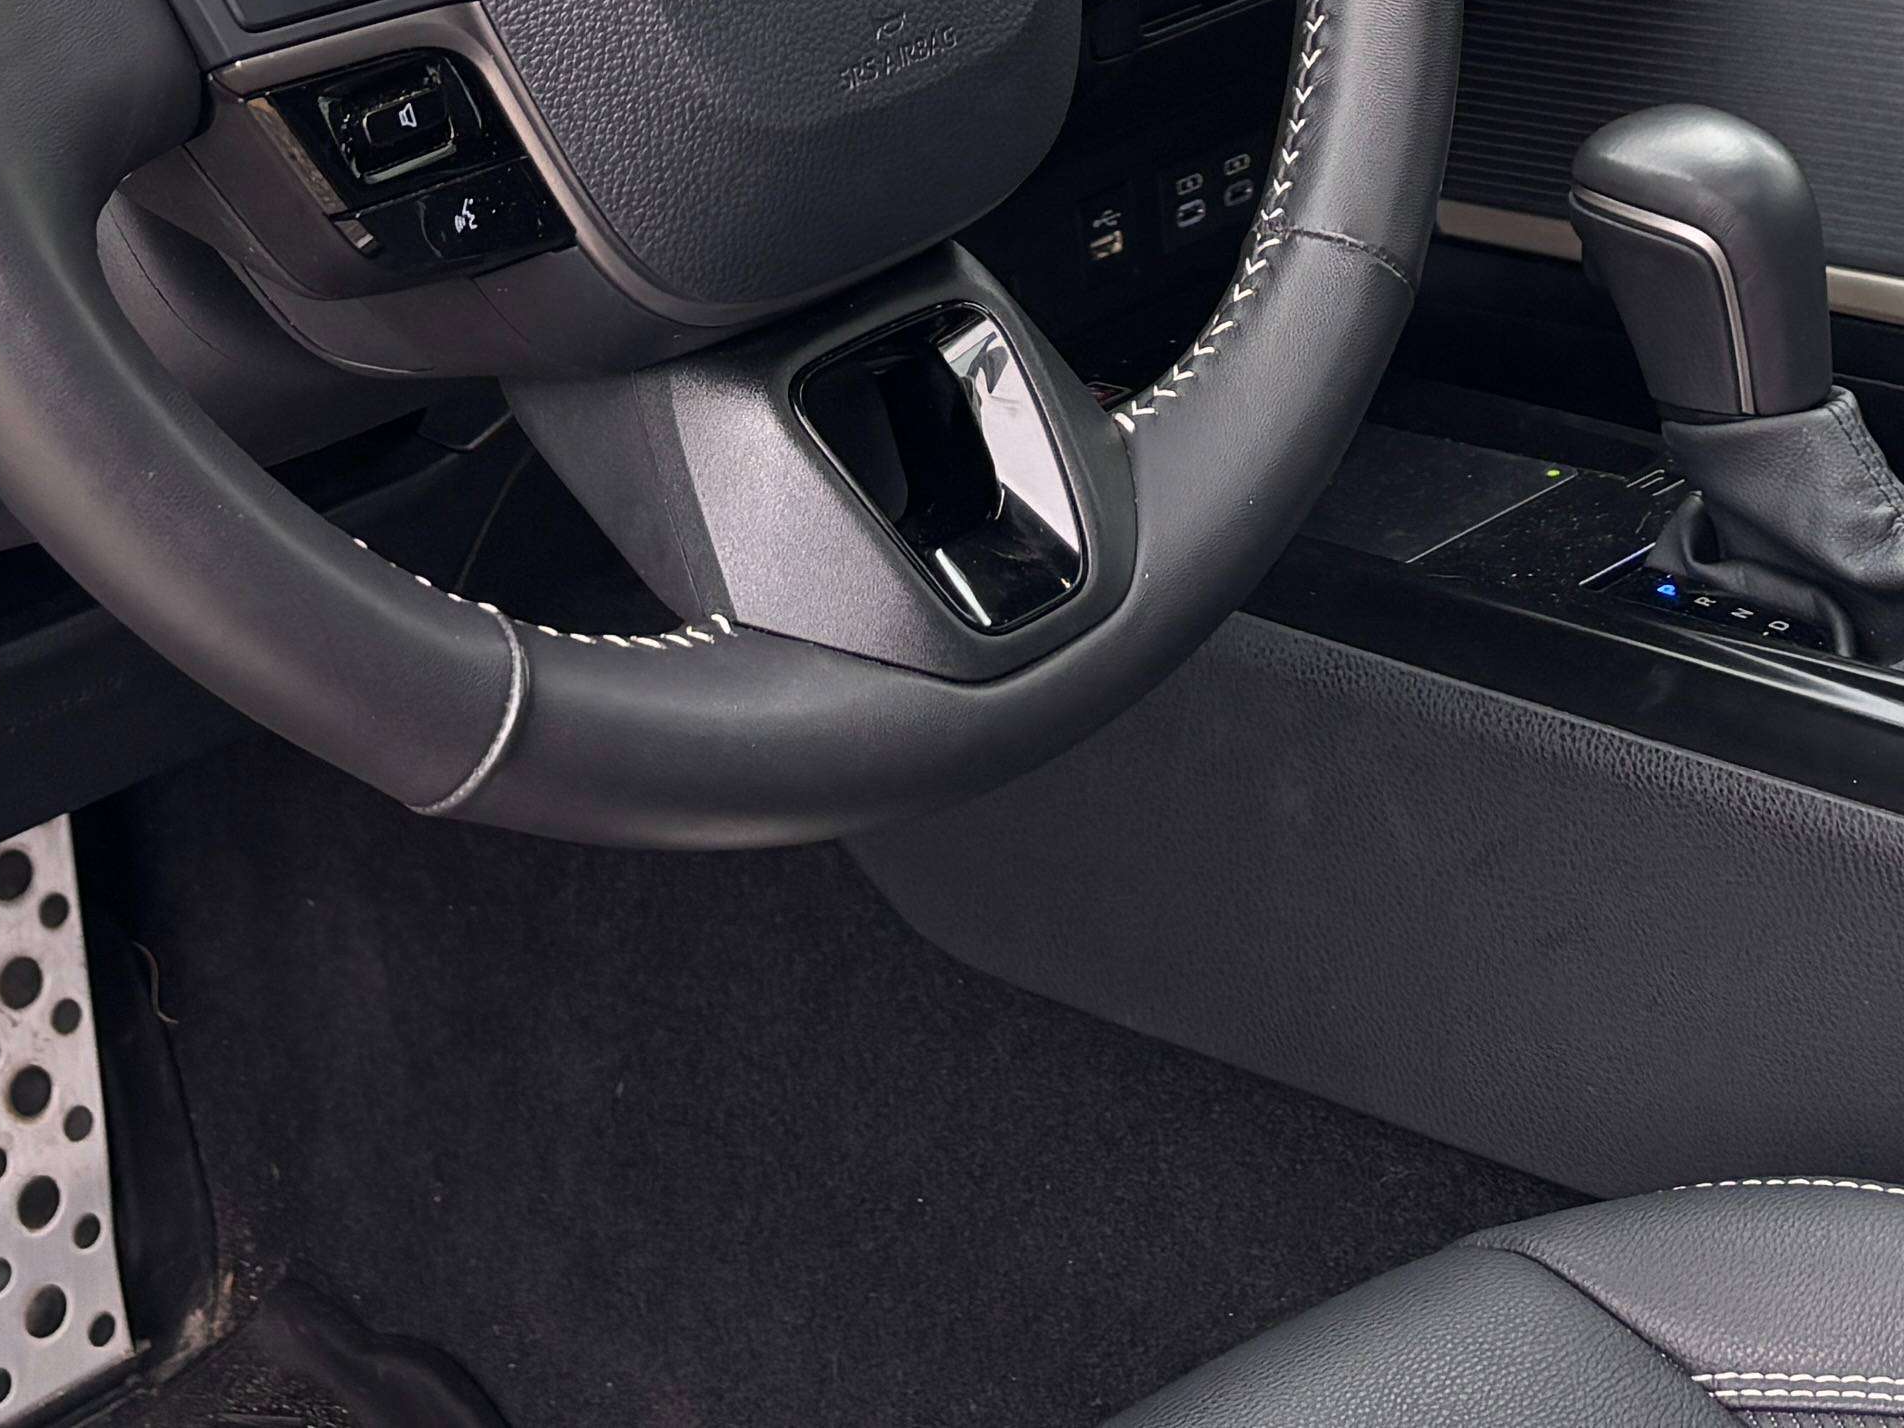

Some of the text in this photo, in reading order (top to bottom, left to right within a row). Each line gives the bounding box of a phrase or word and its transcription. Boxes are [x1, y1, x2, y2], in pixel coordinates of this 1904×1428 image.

[881, 26, 958, 77] AIRBAG
[1656, 583, 1790, 631] P R N D
